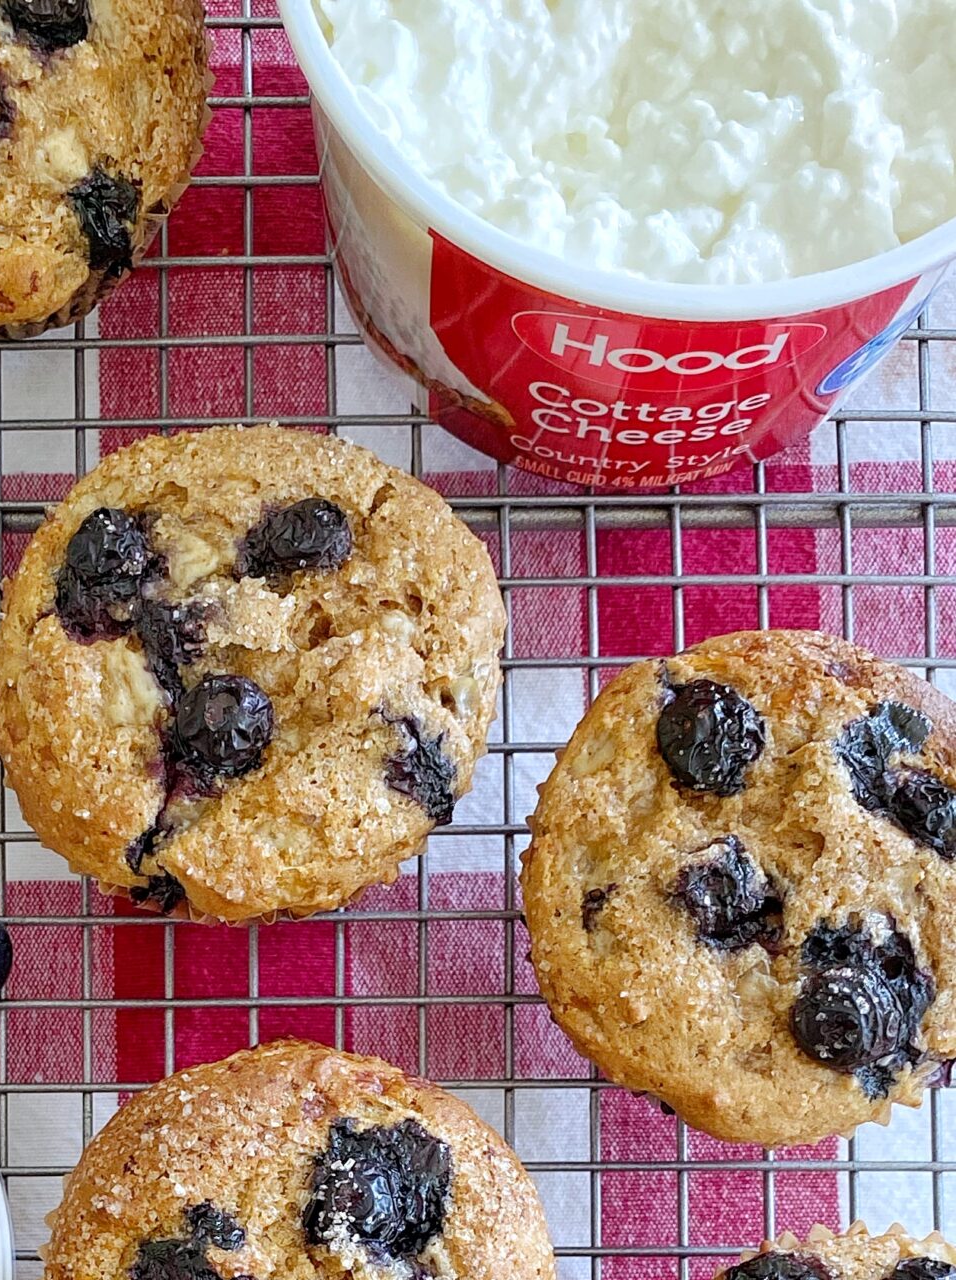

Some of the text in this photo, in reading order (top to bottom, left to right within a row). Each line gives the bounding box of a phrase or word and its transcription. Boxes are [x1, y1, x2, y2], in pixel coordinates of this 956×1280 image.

[549, 322, 790, 375] Hood
[528, 381, 772, 427] Cottage
[531, 406, 753, 446] Cheese
[510, 434, 750, 472] Country Style
[514, 455, 734, 488] SMALL CURD 4% MILKFAT MIN
